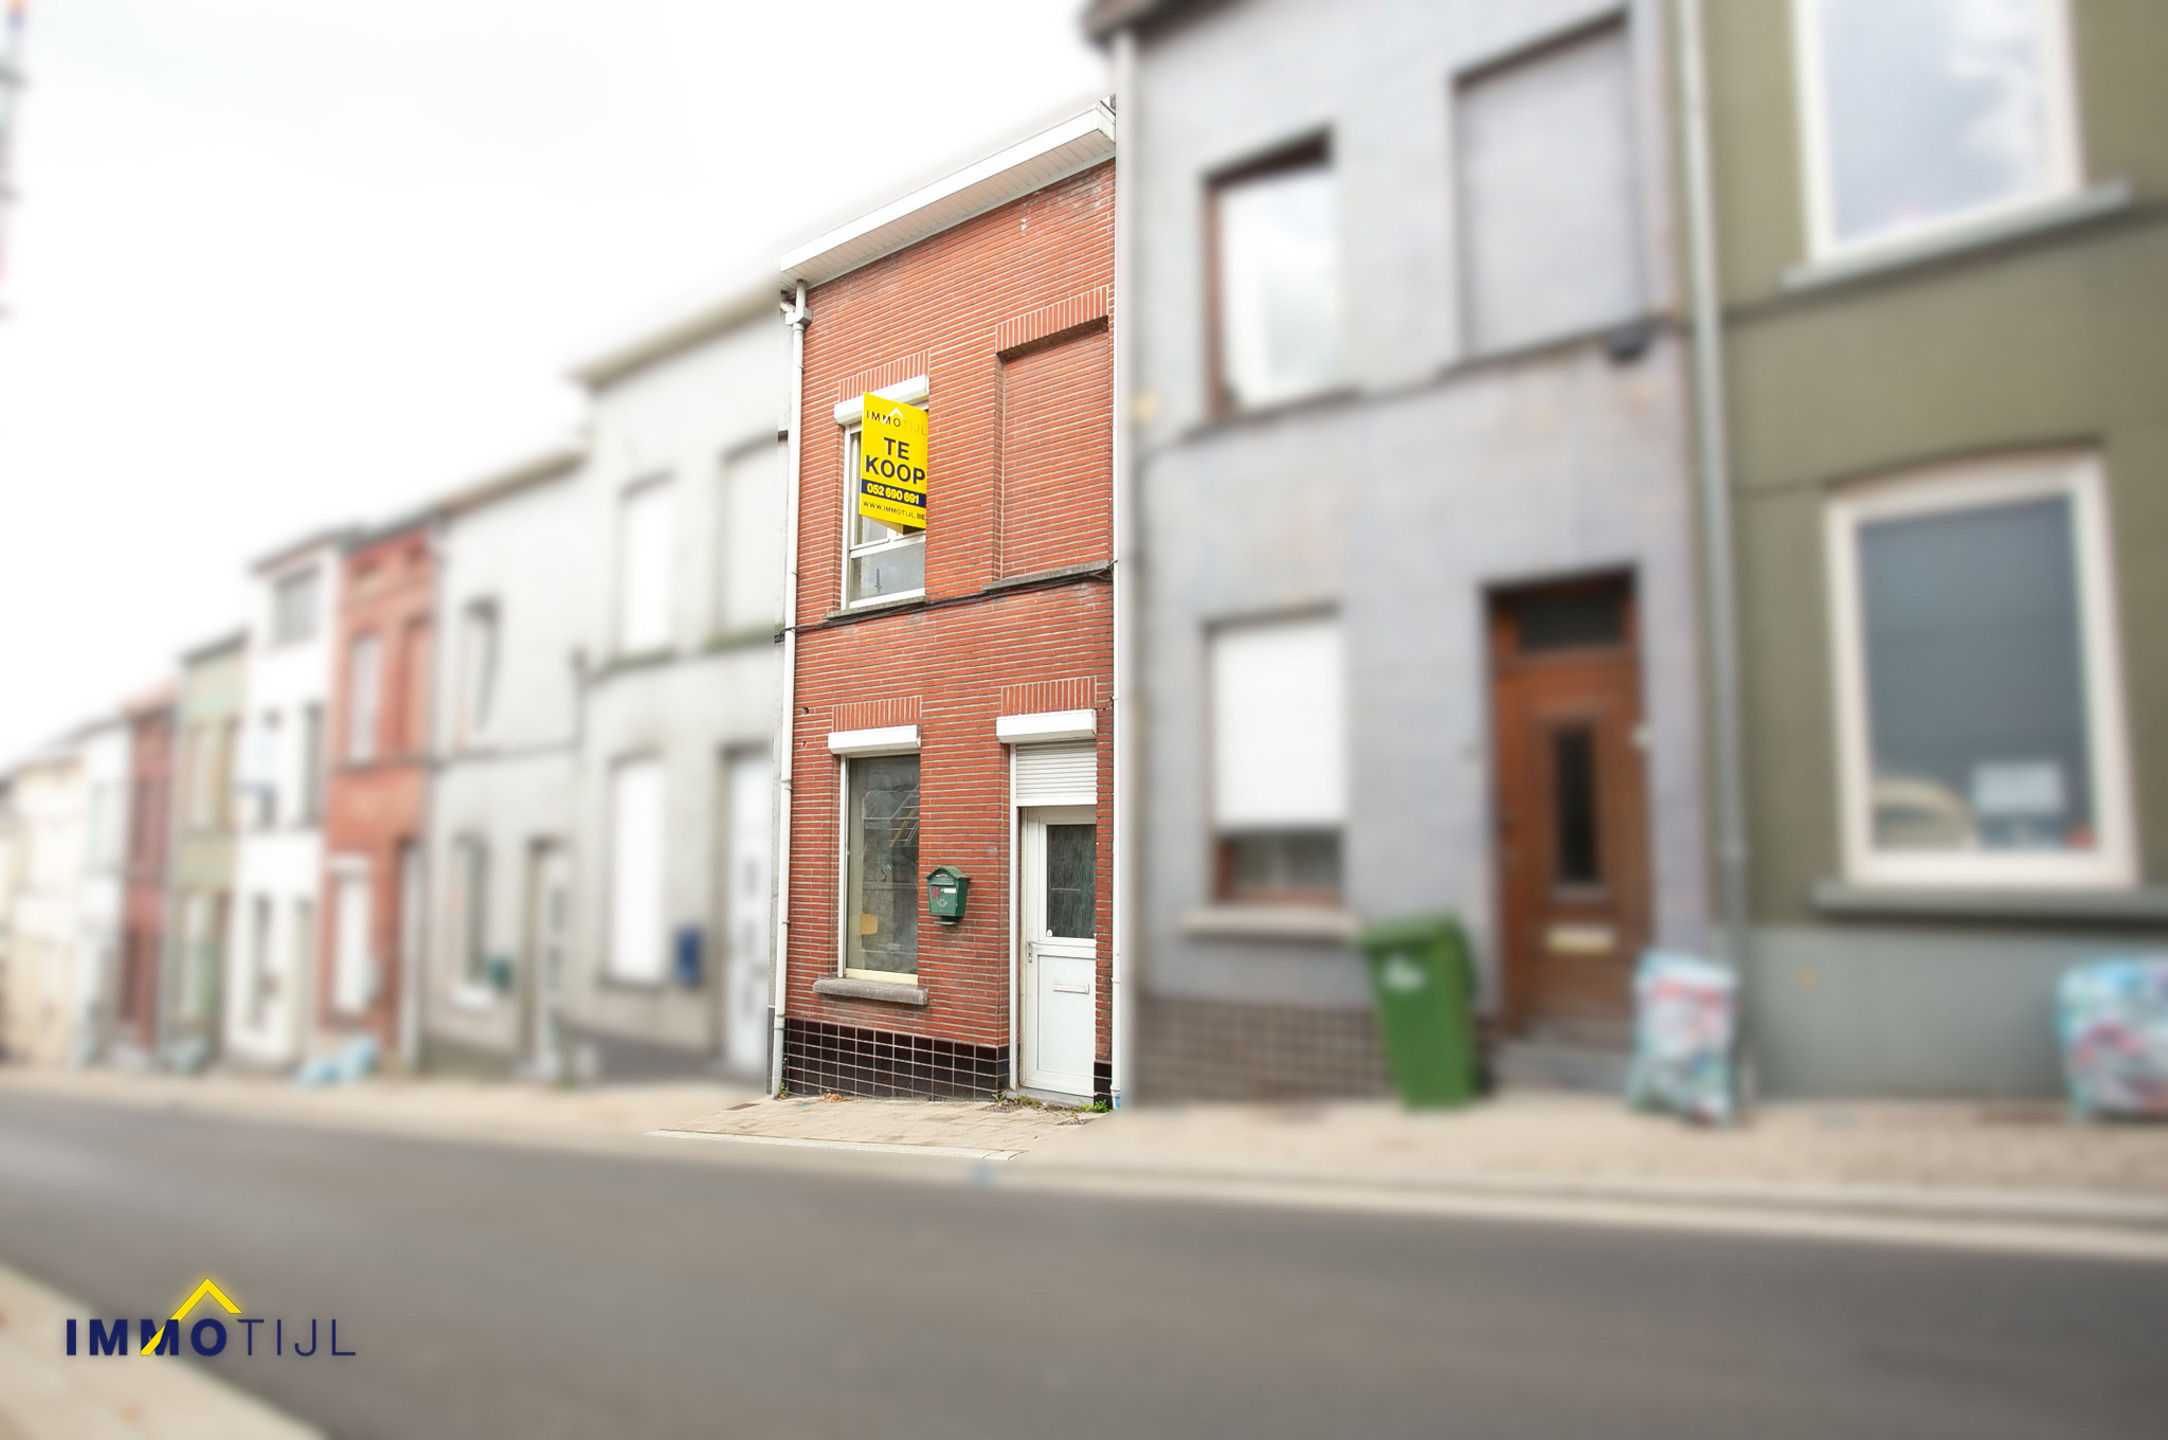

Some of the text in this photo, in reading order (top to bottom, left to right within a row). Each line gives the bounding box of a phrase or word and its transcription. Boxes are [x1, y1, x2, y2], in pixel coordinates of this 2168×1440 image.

[883, 437, 909, 460] TE
[865, 455, 925, 484] KOOP
[866, 482, 885, 496] 052
